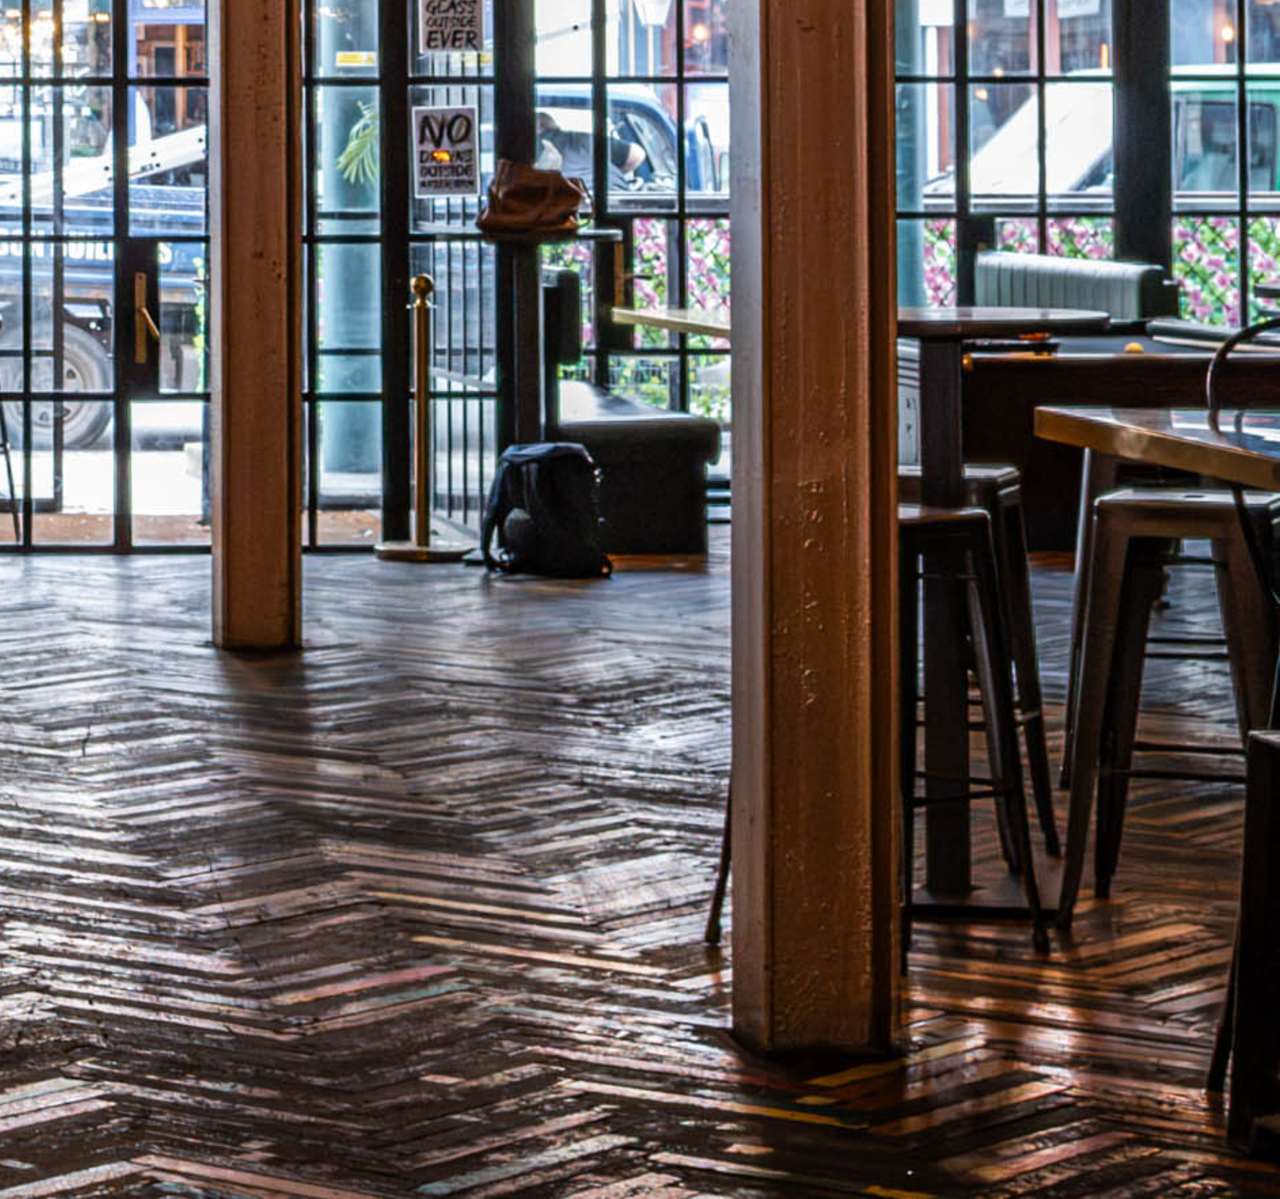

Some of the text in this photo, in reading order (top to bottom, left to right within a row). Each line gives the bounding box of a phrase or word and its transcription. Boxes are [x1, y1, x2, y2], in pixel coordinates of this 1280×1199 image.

[426, 0, 478, 15] GLASS
[425, 15, 477, 29] OUTSIDE
[425, 29, 479, 50] EVER
[419, 114, 472, 148] NO
[420, 164, 473, 177] OUTSIDE
